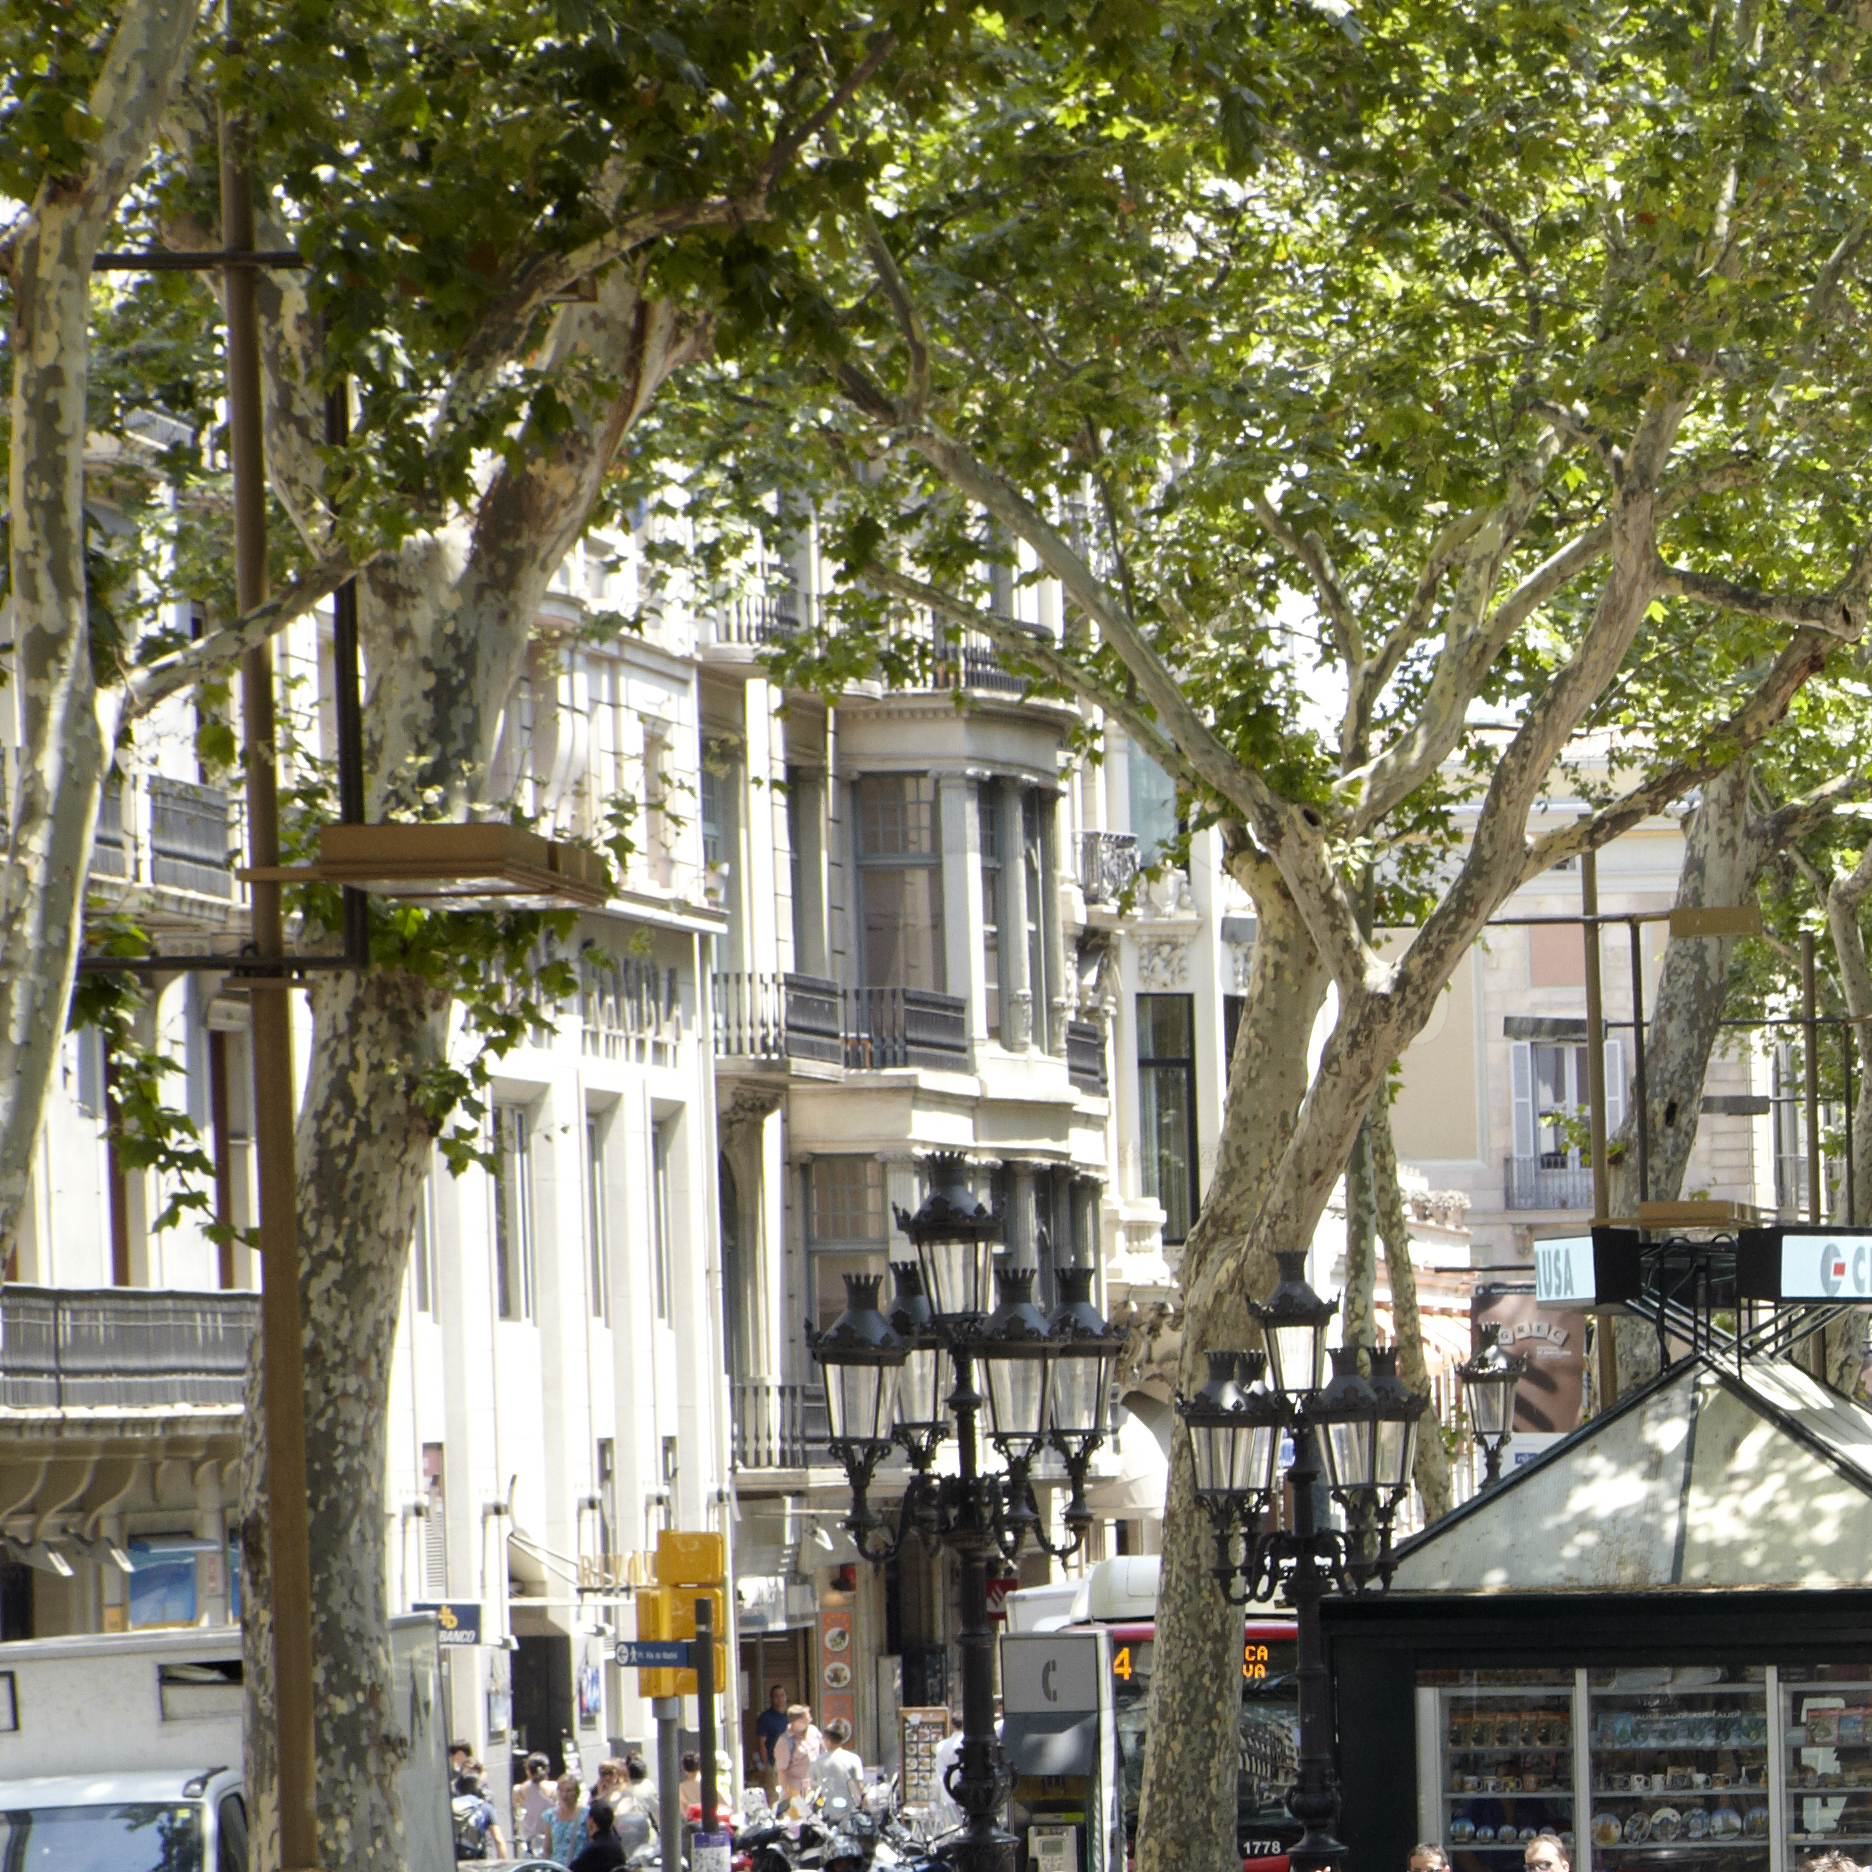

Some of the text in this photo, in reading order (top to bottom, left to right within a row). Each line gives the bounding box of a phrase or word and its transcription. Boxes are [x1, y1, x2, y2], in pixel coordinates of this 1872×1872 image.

[1501, 1322, 1565, 1345] GREC
[1244, 1645, 1269, 1661] CA
[1242, 1663, 1266, 1679] VA
[1243, 1840, 1281, 1855] 1778
